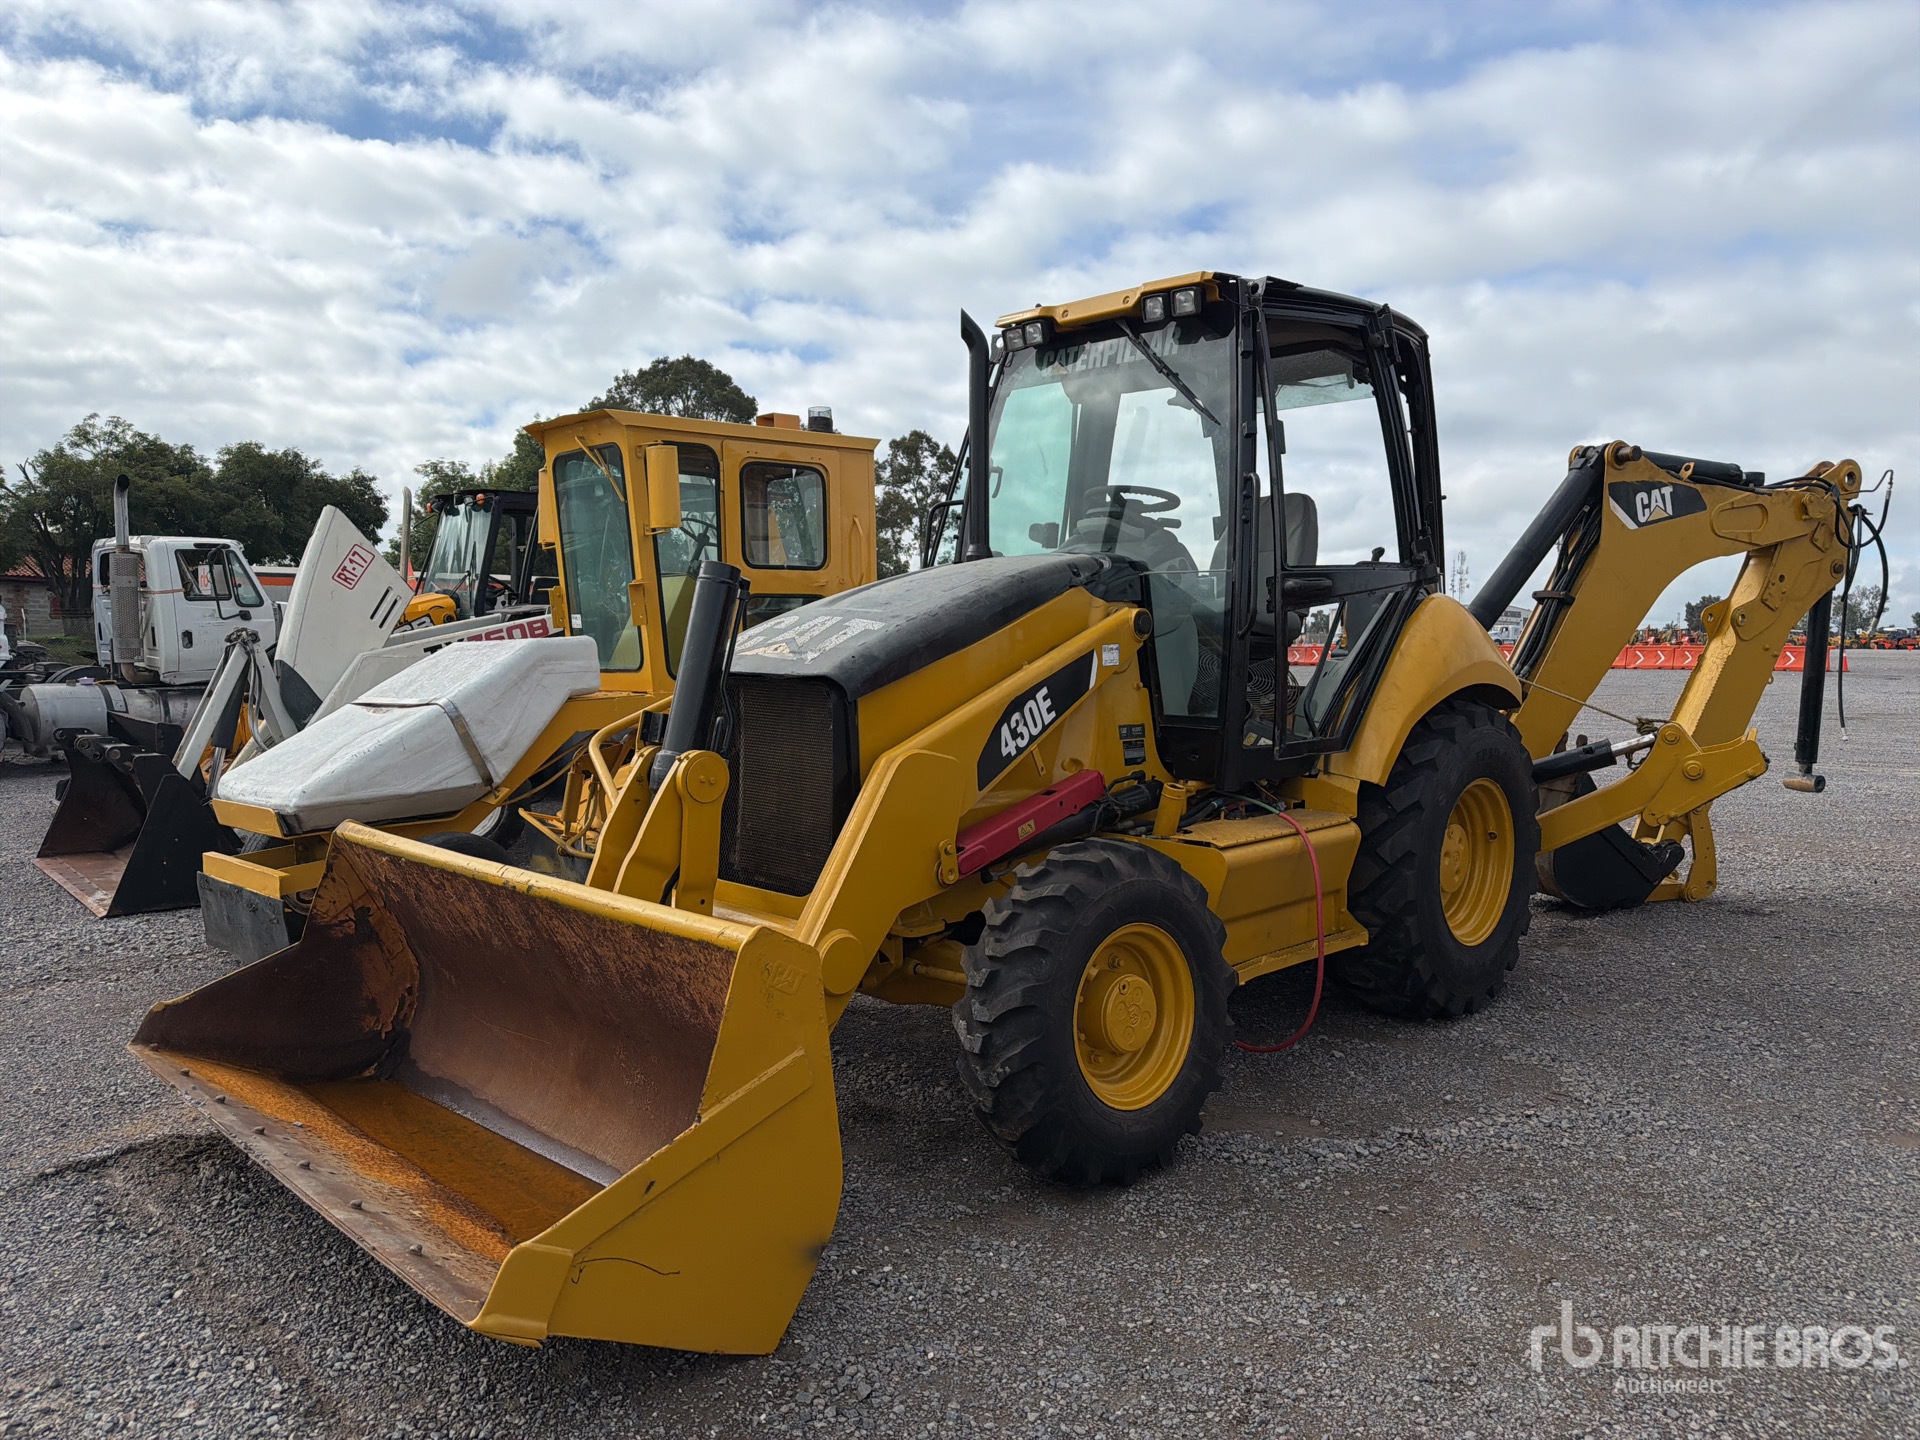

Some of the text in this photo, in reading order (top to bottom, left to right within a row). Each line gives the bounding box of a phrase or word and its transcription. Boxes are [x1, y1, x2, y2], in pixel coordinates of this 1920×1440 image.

[1635, 485, 1674, 524] CAT
[336, 550, 368, 586] RT-17
[734, 615, 886, 665] CAT
[1000, 686, 1057, 757] 430E
